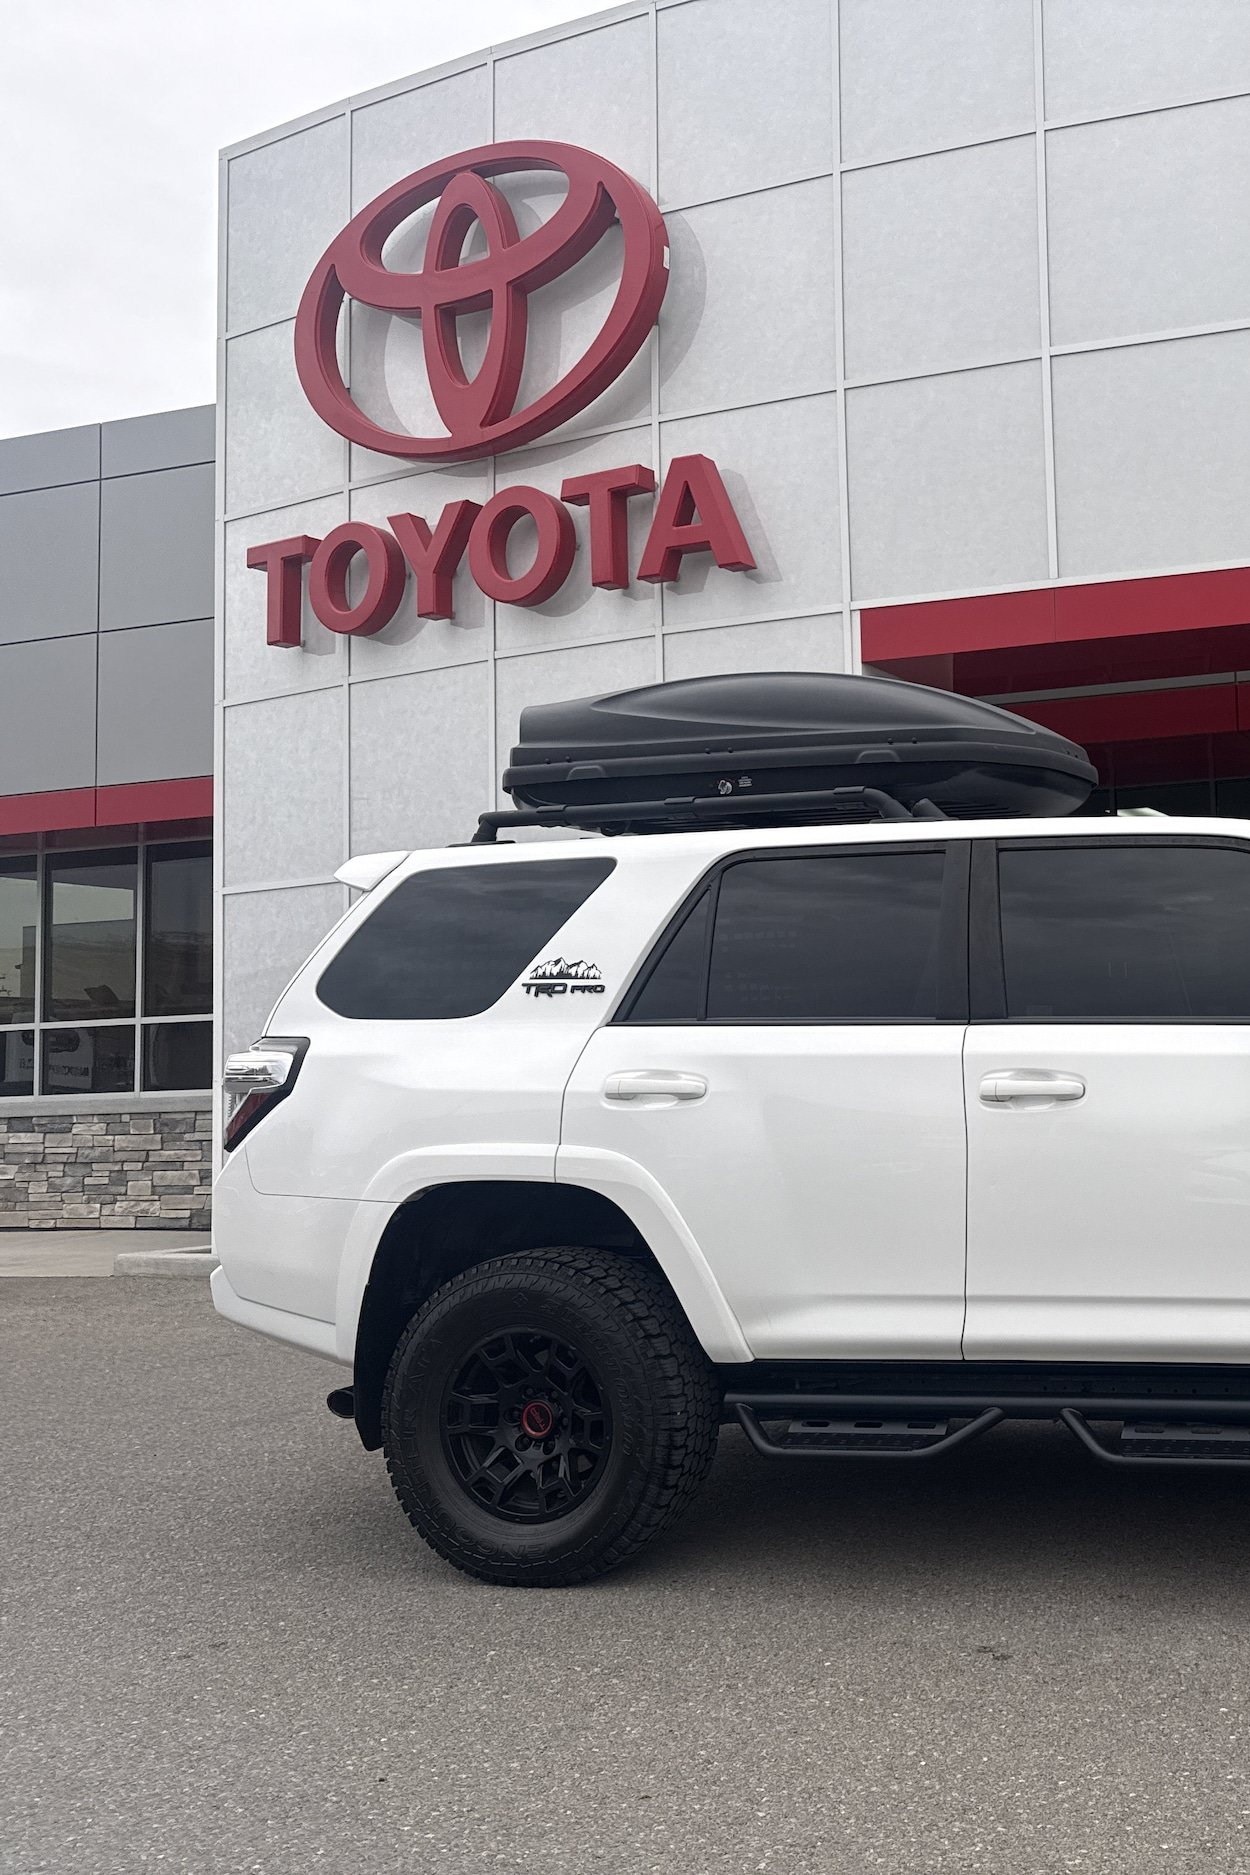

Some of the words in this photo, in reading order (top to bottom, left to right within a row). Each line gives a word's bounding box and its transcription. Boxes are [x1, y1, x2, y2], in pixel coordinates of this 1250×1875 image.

[247, 454, 757, 648] TOYOTA
[521, 982, 568, 998] TRD
[570, 984, 606, 994] PRO
